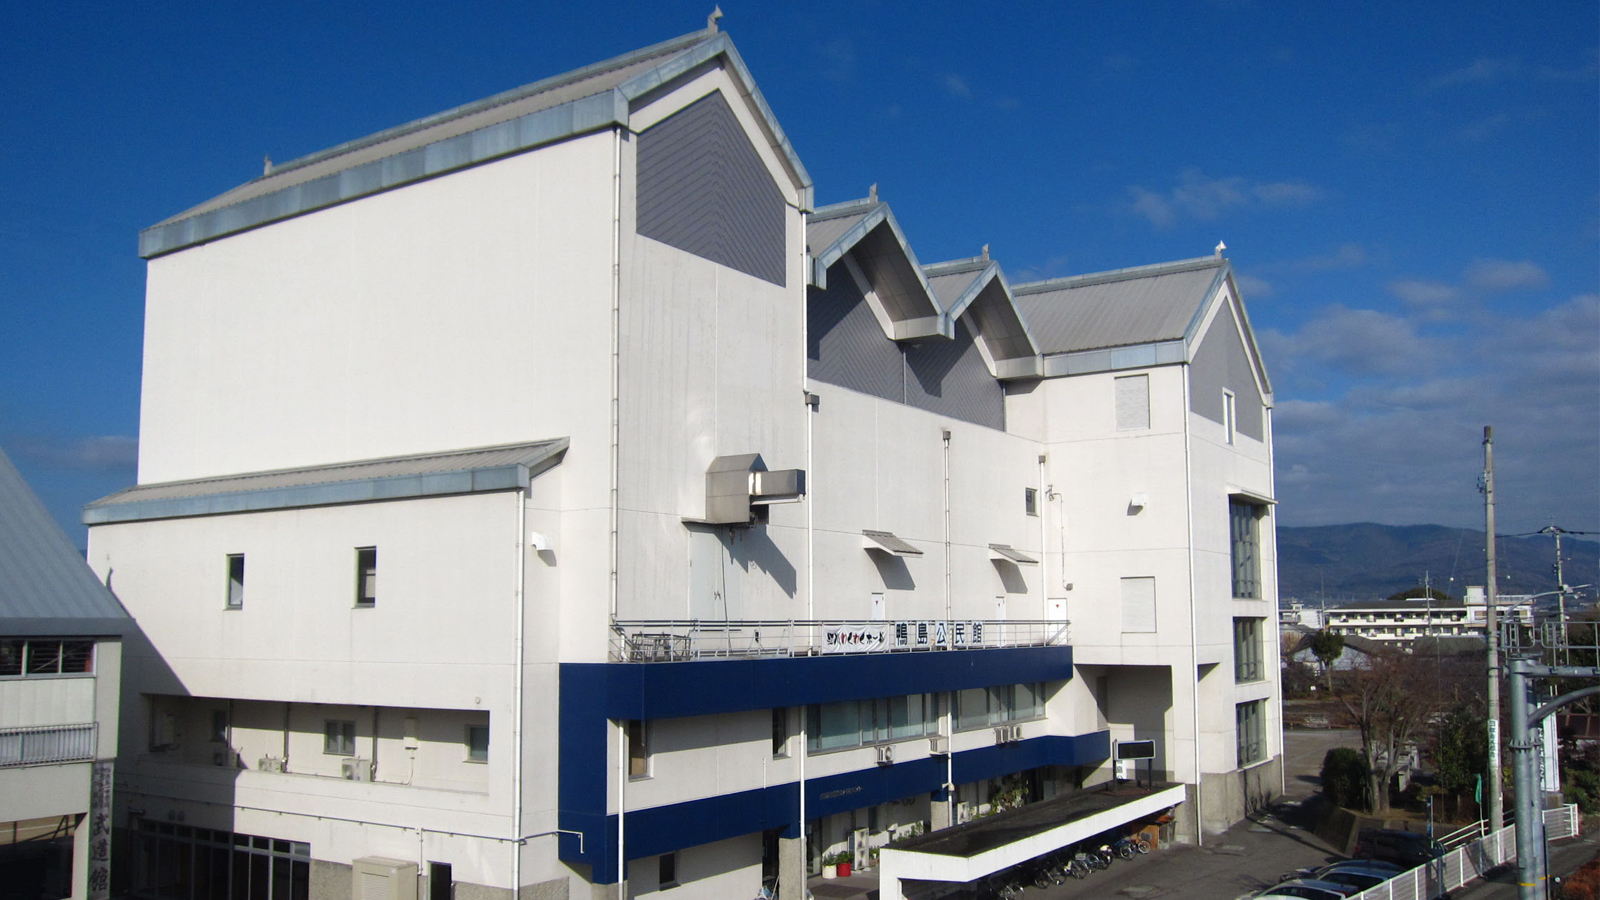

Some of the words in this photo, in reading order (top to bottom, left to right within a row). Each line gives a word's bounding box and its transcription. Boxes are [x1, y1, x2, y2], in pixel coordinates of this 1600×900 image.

[896, 622, 982, 646] 鴨島公民館
